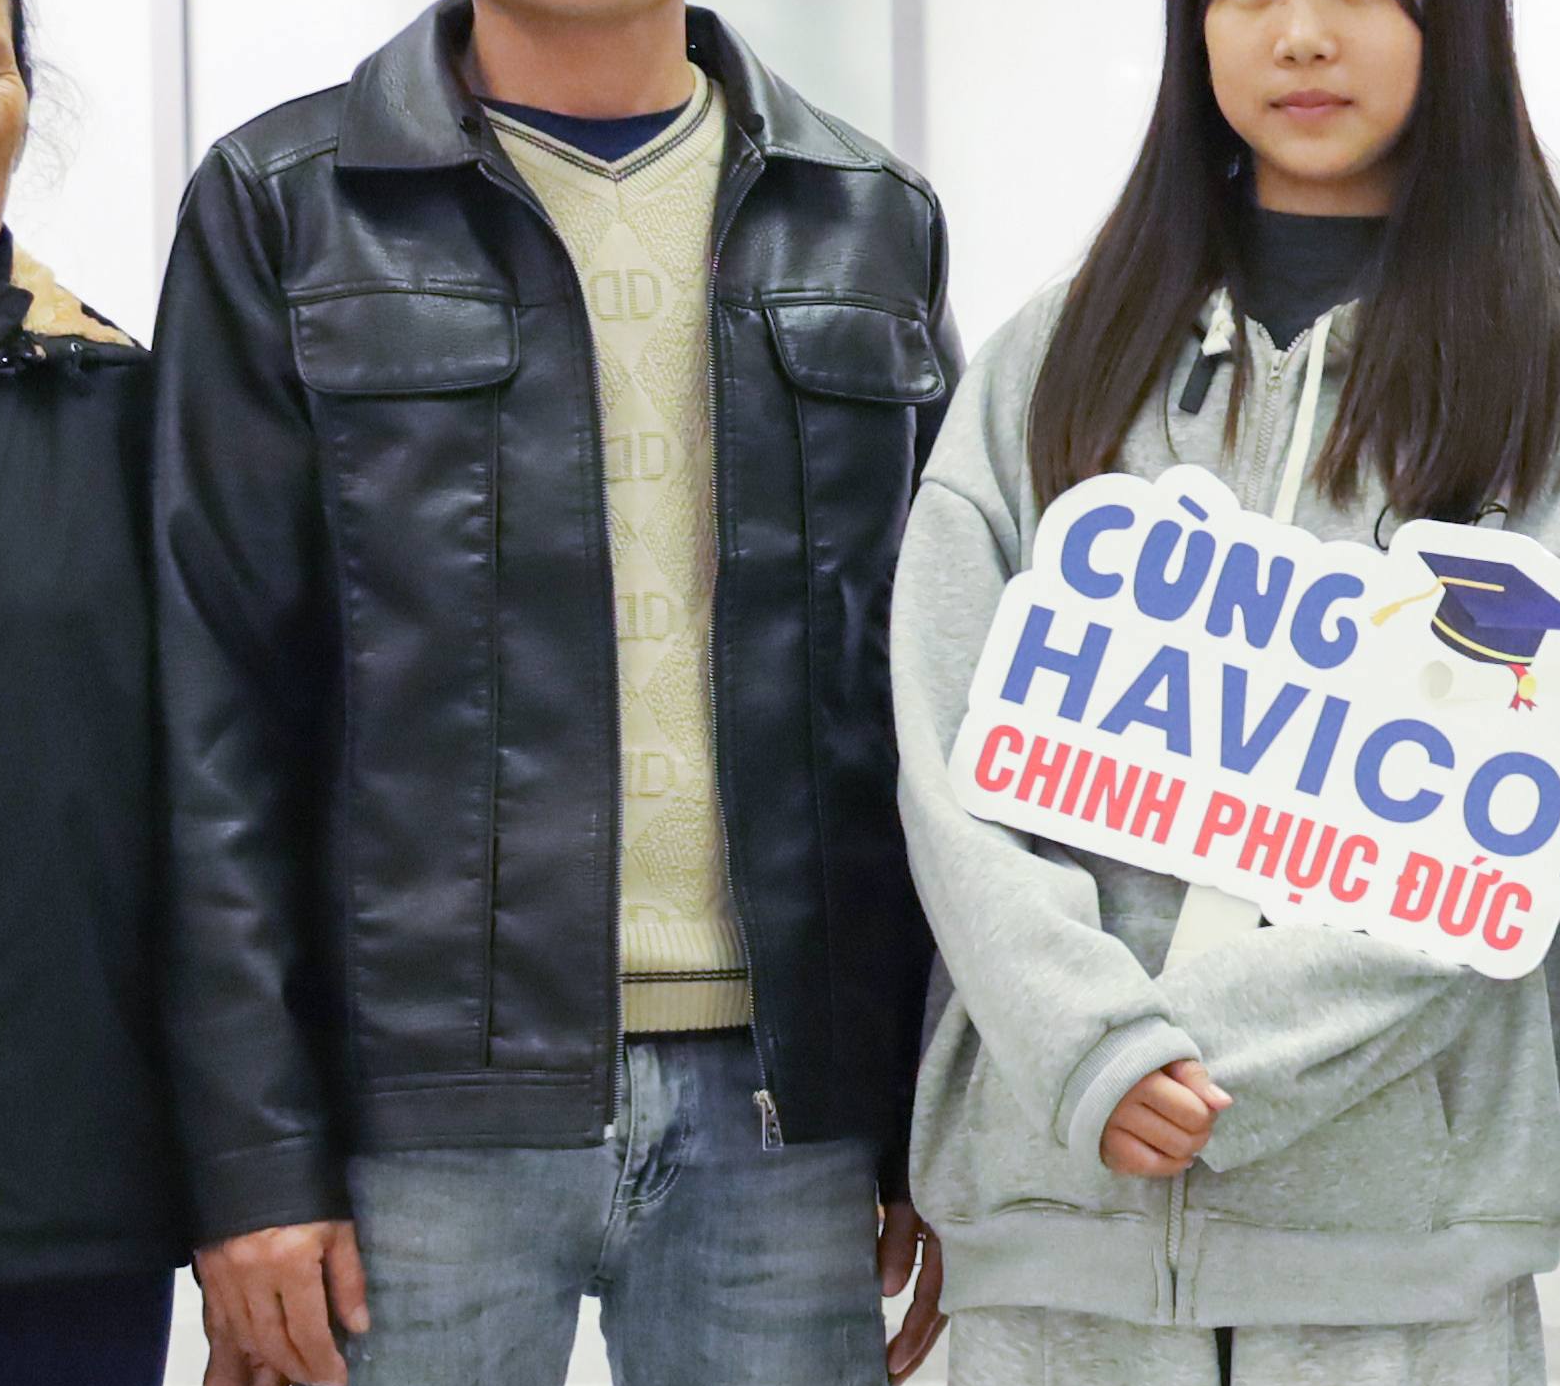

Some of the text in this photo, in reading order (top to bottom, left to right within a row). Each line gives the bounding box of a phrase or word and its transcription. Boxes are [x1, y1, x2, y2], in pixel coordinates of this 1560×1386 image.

[1060, 494, 1365, 670] CÙNG
[974, 724, 1533, 952] CHINH PHỤC ĐỨC
